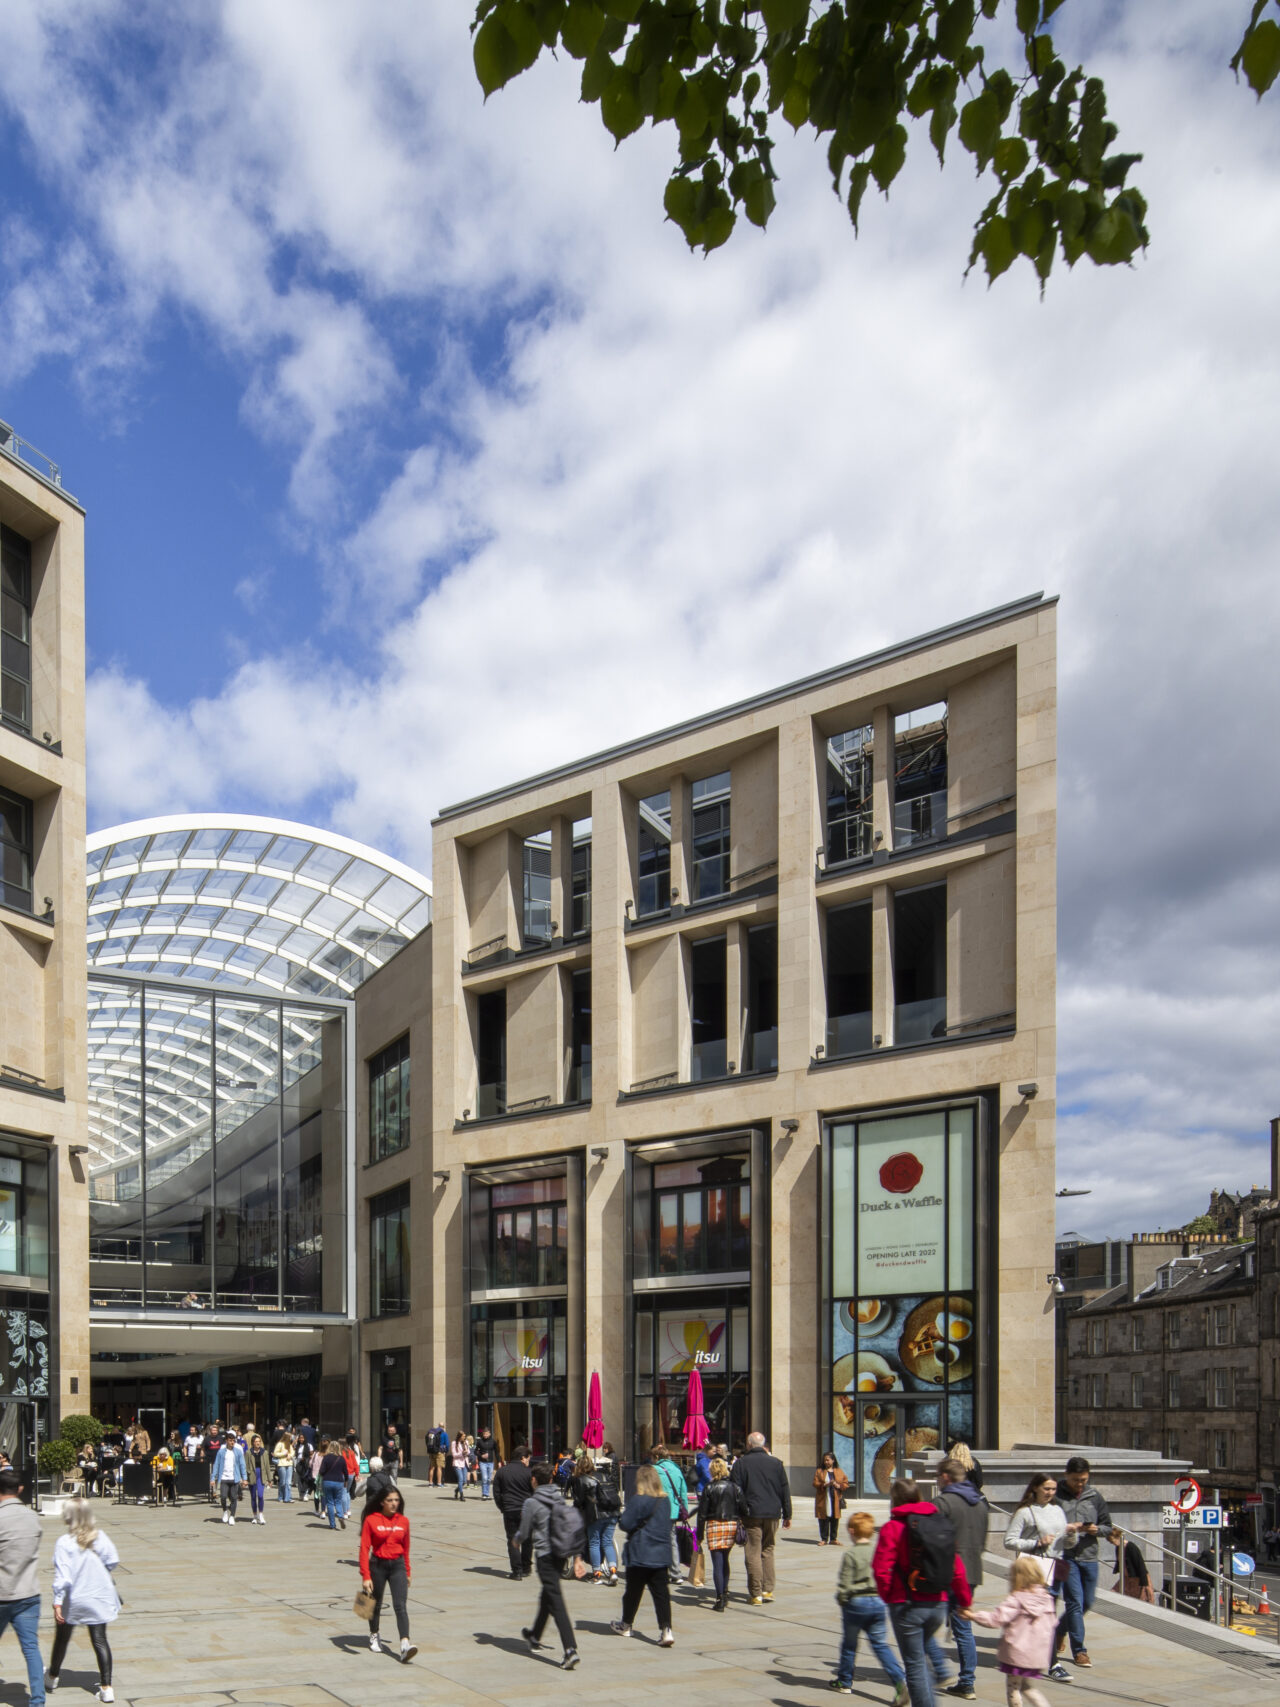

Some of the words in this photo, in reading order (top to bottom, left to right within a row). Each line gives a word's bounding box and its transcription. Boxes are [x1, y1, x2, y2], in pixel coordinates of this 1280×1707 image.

[860, 1200, 892, 1212] Duck
[902, 1196, 943, 1208] Waffle
[866, 1252, 899, 1260] OPENING
[901, 1250, 917, 1258] LATE
[919, 1249, 937, 1257] 2022
[521, 1356, 543, 1368] itsu
[694, 1350, 720, 1364] itsu
[1174, 1508, 1200, 1516] Jes
[1206, 1511, 1216, 1523] P
[1163, 1517, 1197, 1525] Quaer
